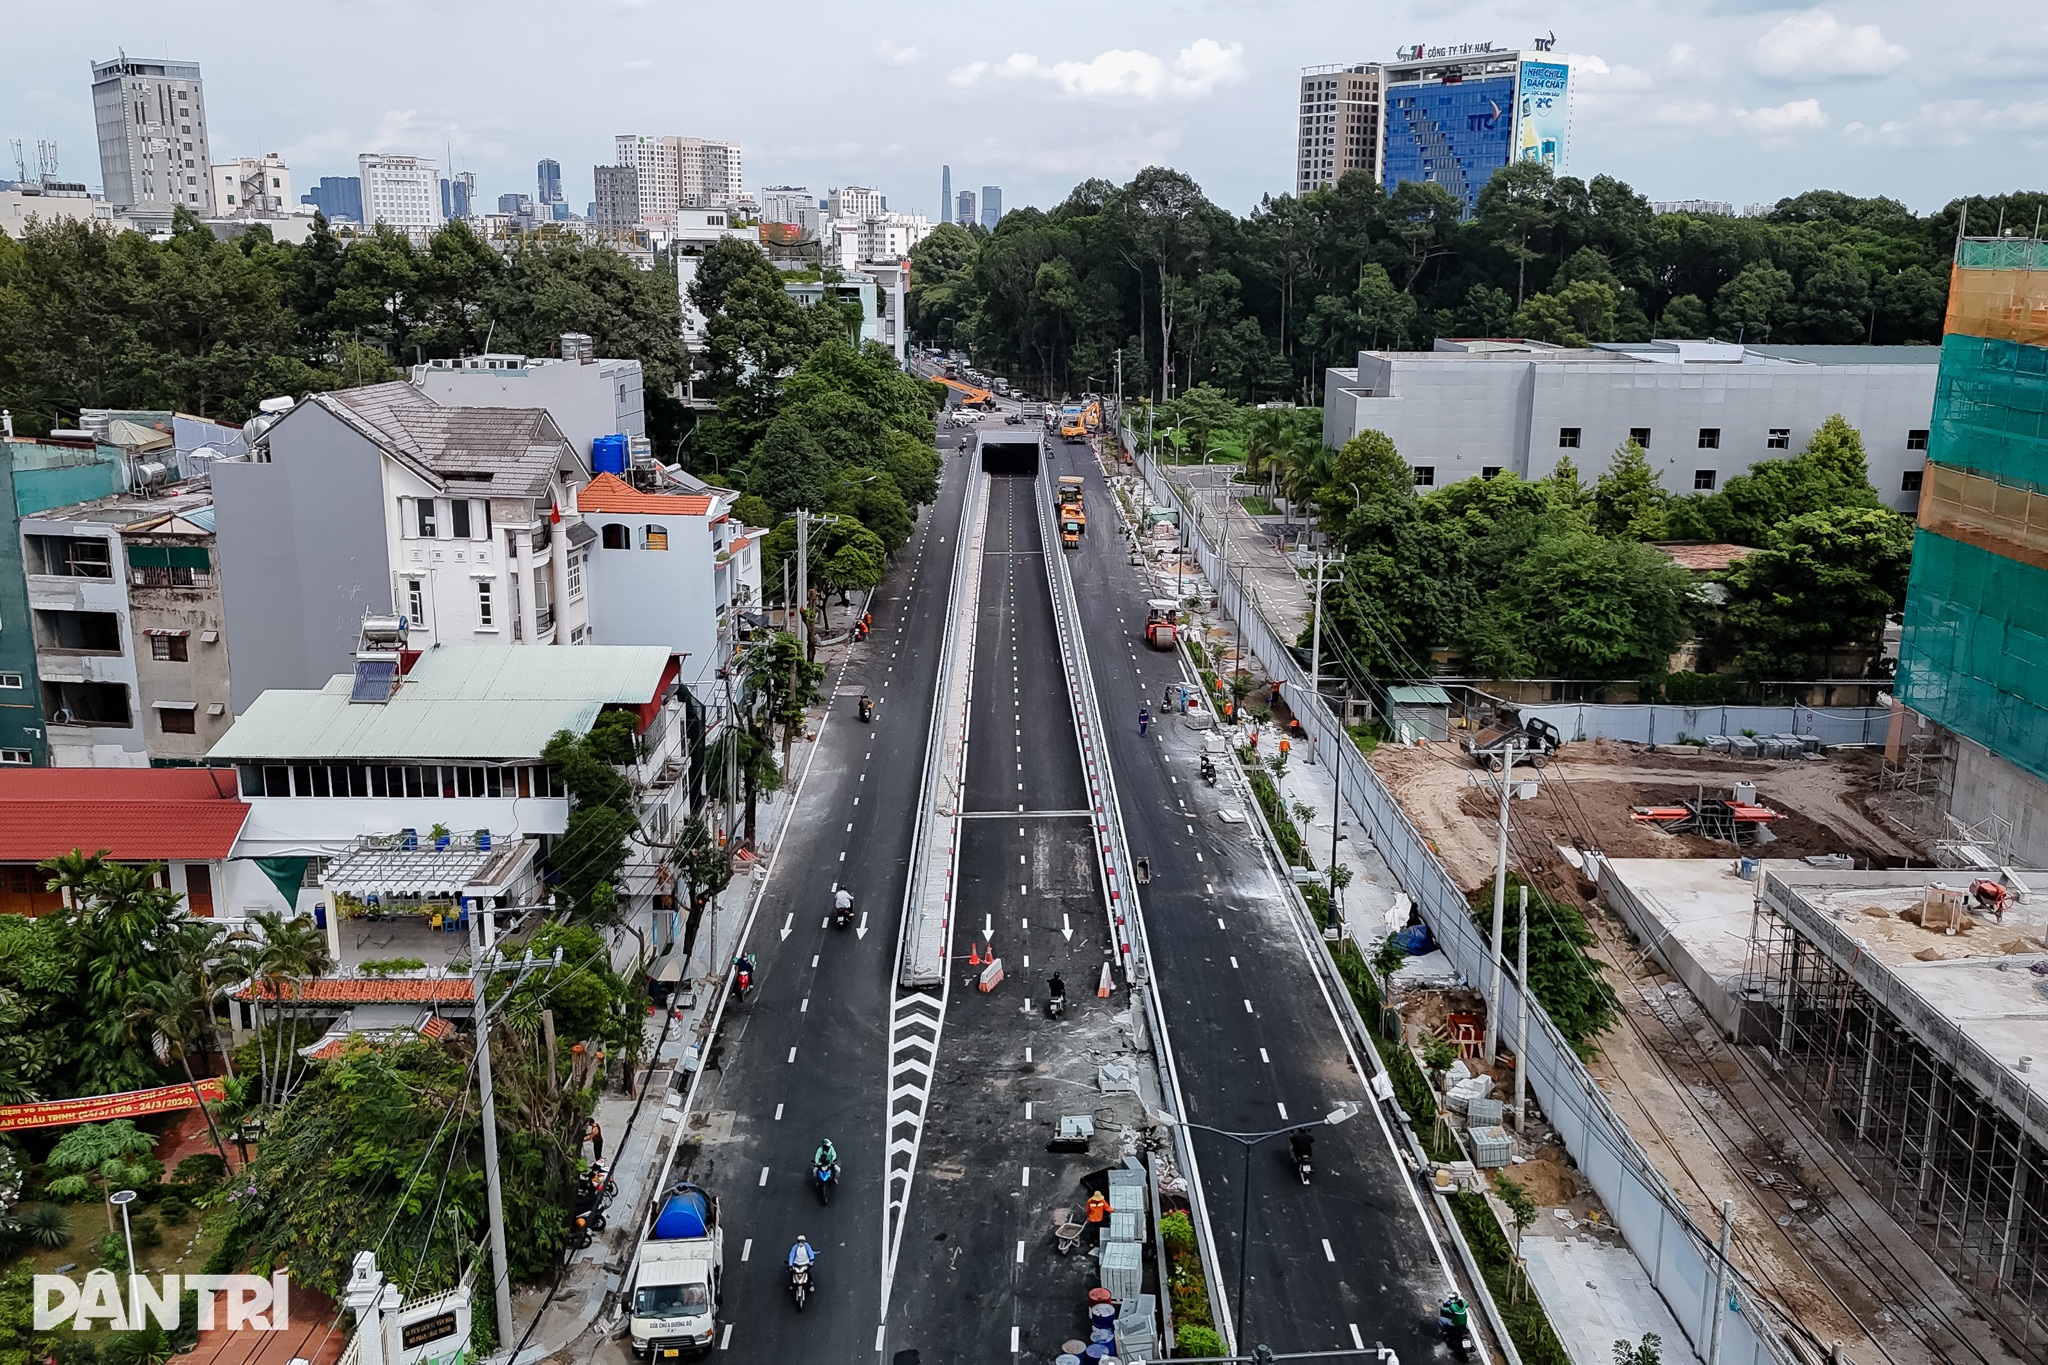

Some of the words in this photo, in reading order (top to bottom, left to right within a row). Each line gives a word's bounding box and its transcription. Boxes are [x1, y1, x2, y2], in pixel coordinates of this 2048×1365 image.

[1428, 46, 1446, 58] CÔNG
[1449, 45, 1457, 55] TY
[1460, 43, 1473, 54] TÂY
[1475, 42, 1490, 53] NAM
[1544, 69, 1564, 79] CHILL
[1468, 114, 1495, 131] TTC
[17, 1115, 45, 1125] CHÂU
[47, 1112, 75, 1122] TRINH
[139, 1097, 193, 1111] 24/3/2024)
